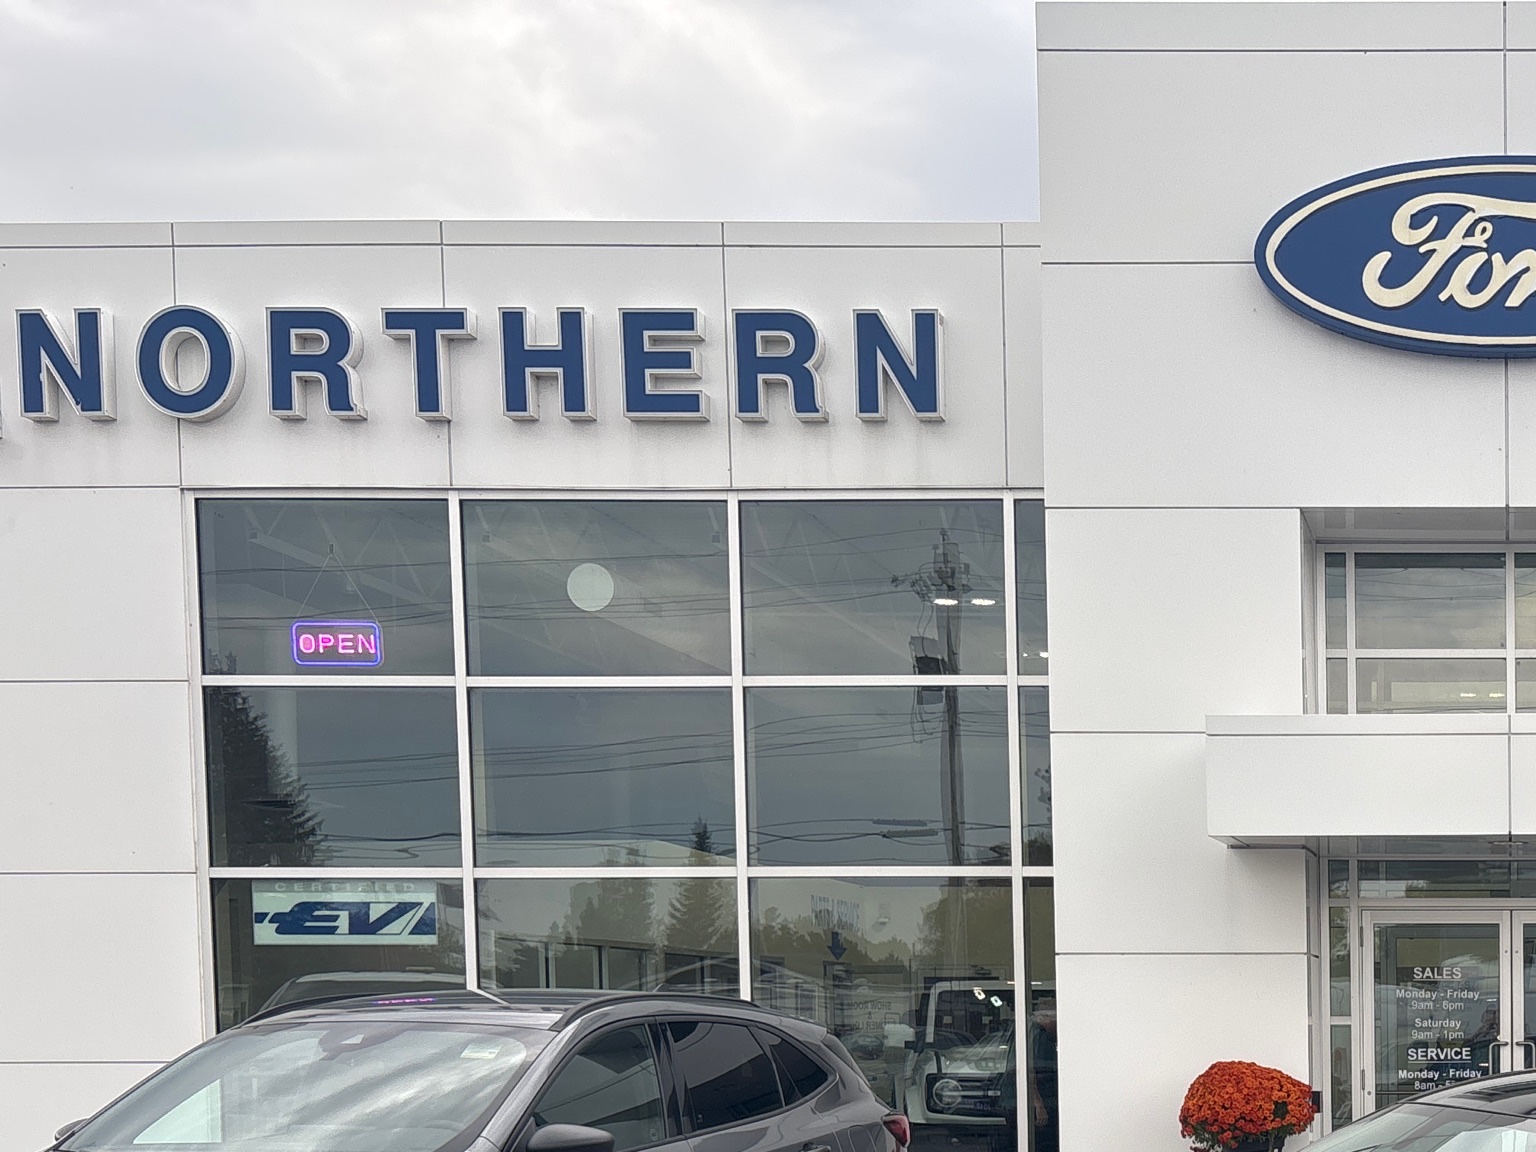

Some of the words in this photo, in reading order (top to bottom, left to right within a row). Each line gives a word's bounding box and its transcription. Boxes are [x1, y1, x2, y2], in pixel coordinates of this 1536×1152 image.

[15, 305, 945, 422] NORTHERN
[299, 633, 376, 654] OPEN
[274, 882, 416, 892] CERTIFIED
[1413, 967, 1462, 979] SALES
[1396, 989, 1437, 1000] Monday
[1447, 989, 1479, 1000] Friday
[1412, 1001, 1432, 1010] 9am
[1443, 1001, 1464, 1011] 6pm
[1415, 1018, 1461, 1029] Saturday
[1412, 1030, 1433, 1039] 9am
[1443, 1030, 1464, 1040] 1pm
[1408, 1048, 1472, 1060] SERVICE
[1398, 1069, 1439, 1080] Monday
[1449, 1069, 1482, 1078] Friday
[1414, 1081, 1435, 1090] 8am
